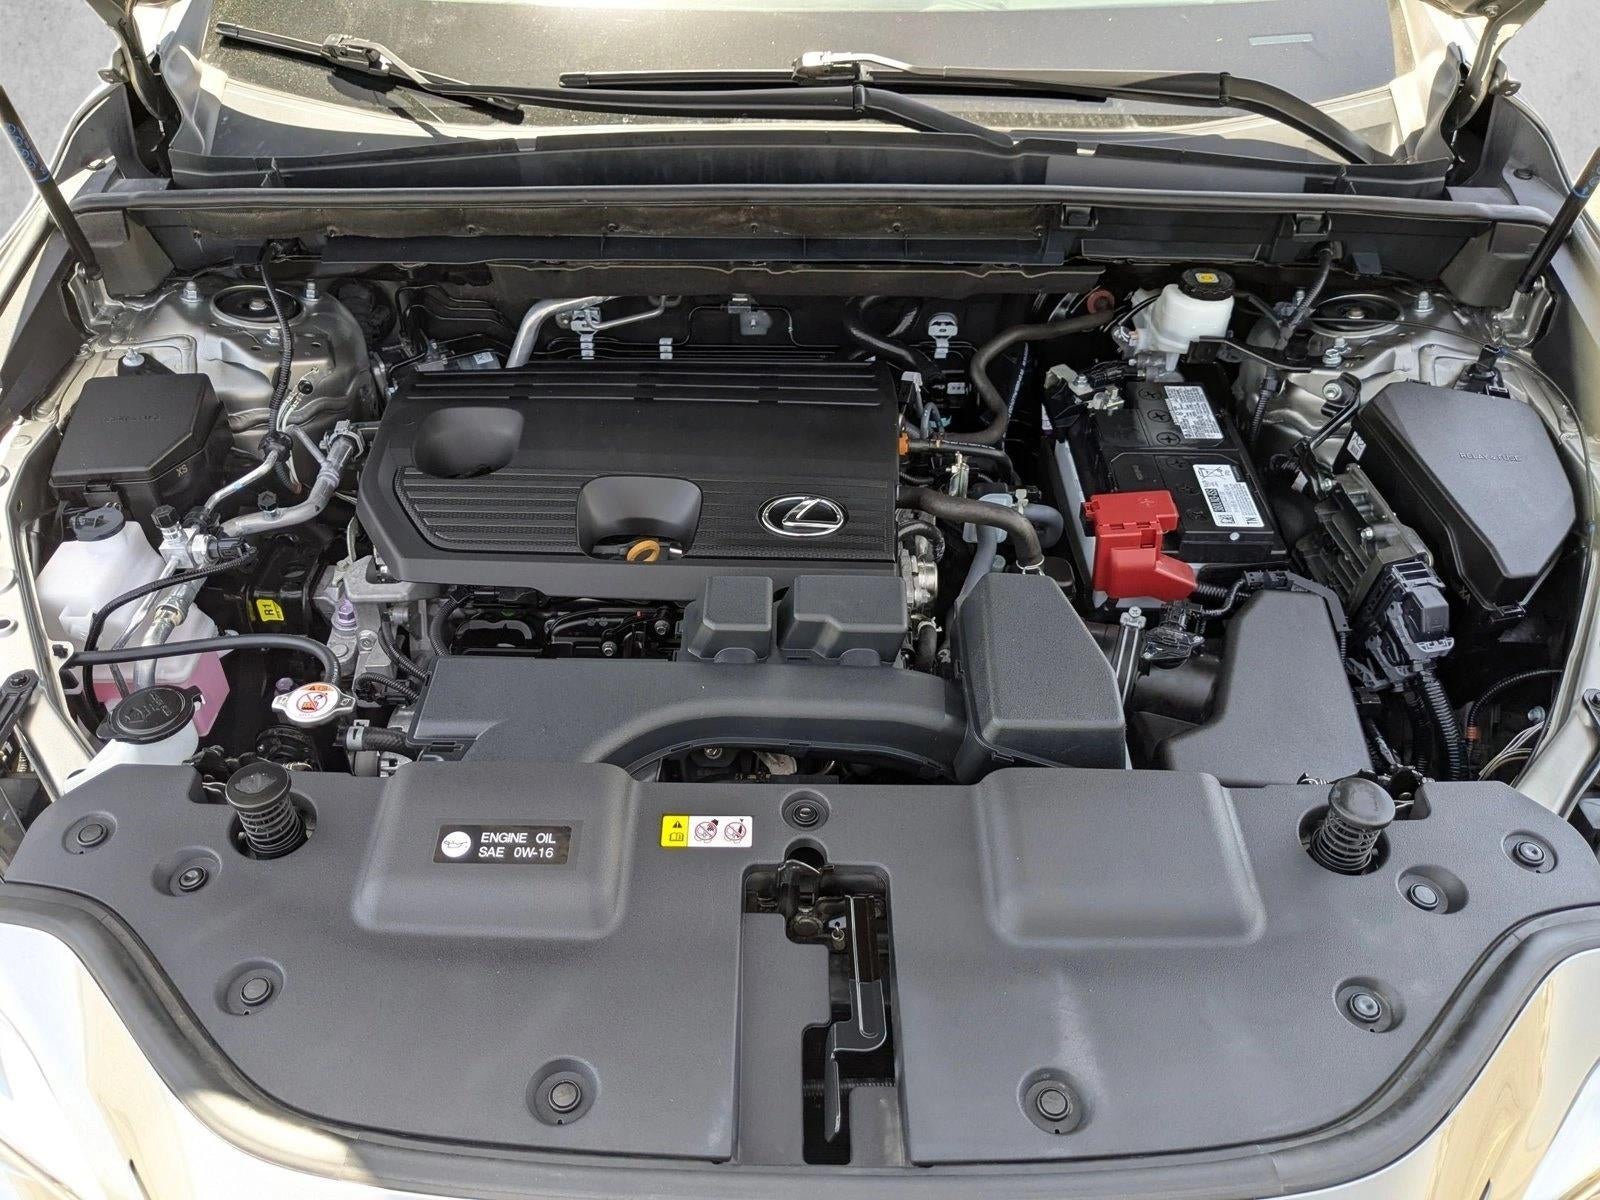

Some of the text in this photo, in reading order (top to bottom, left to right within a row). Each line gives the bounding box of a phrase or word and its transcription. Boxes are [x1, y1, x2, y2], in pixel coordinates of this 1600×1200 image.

[480, 832, 556, 844] ENGINE OIL
[478, 846, 554, 858] SAE 0W-16
